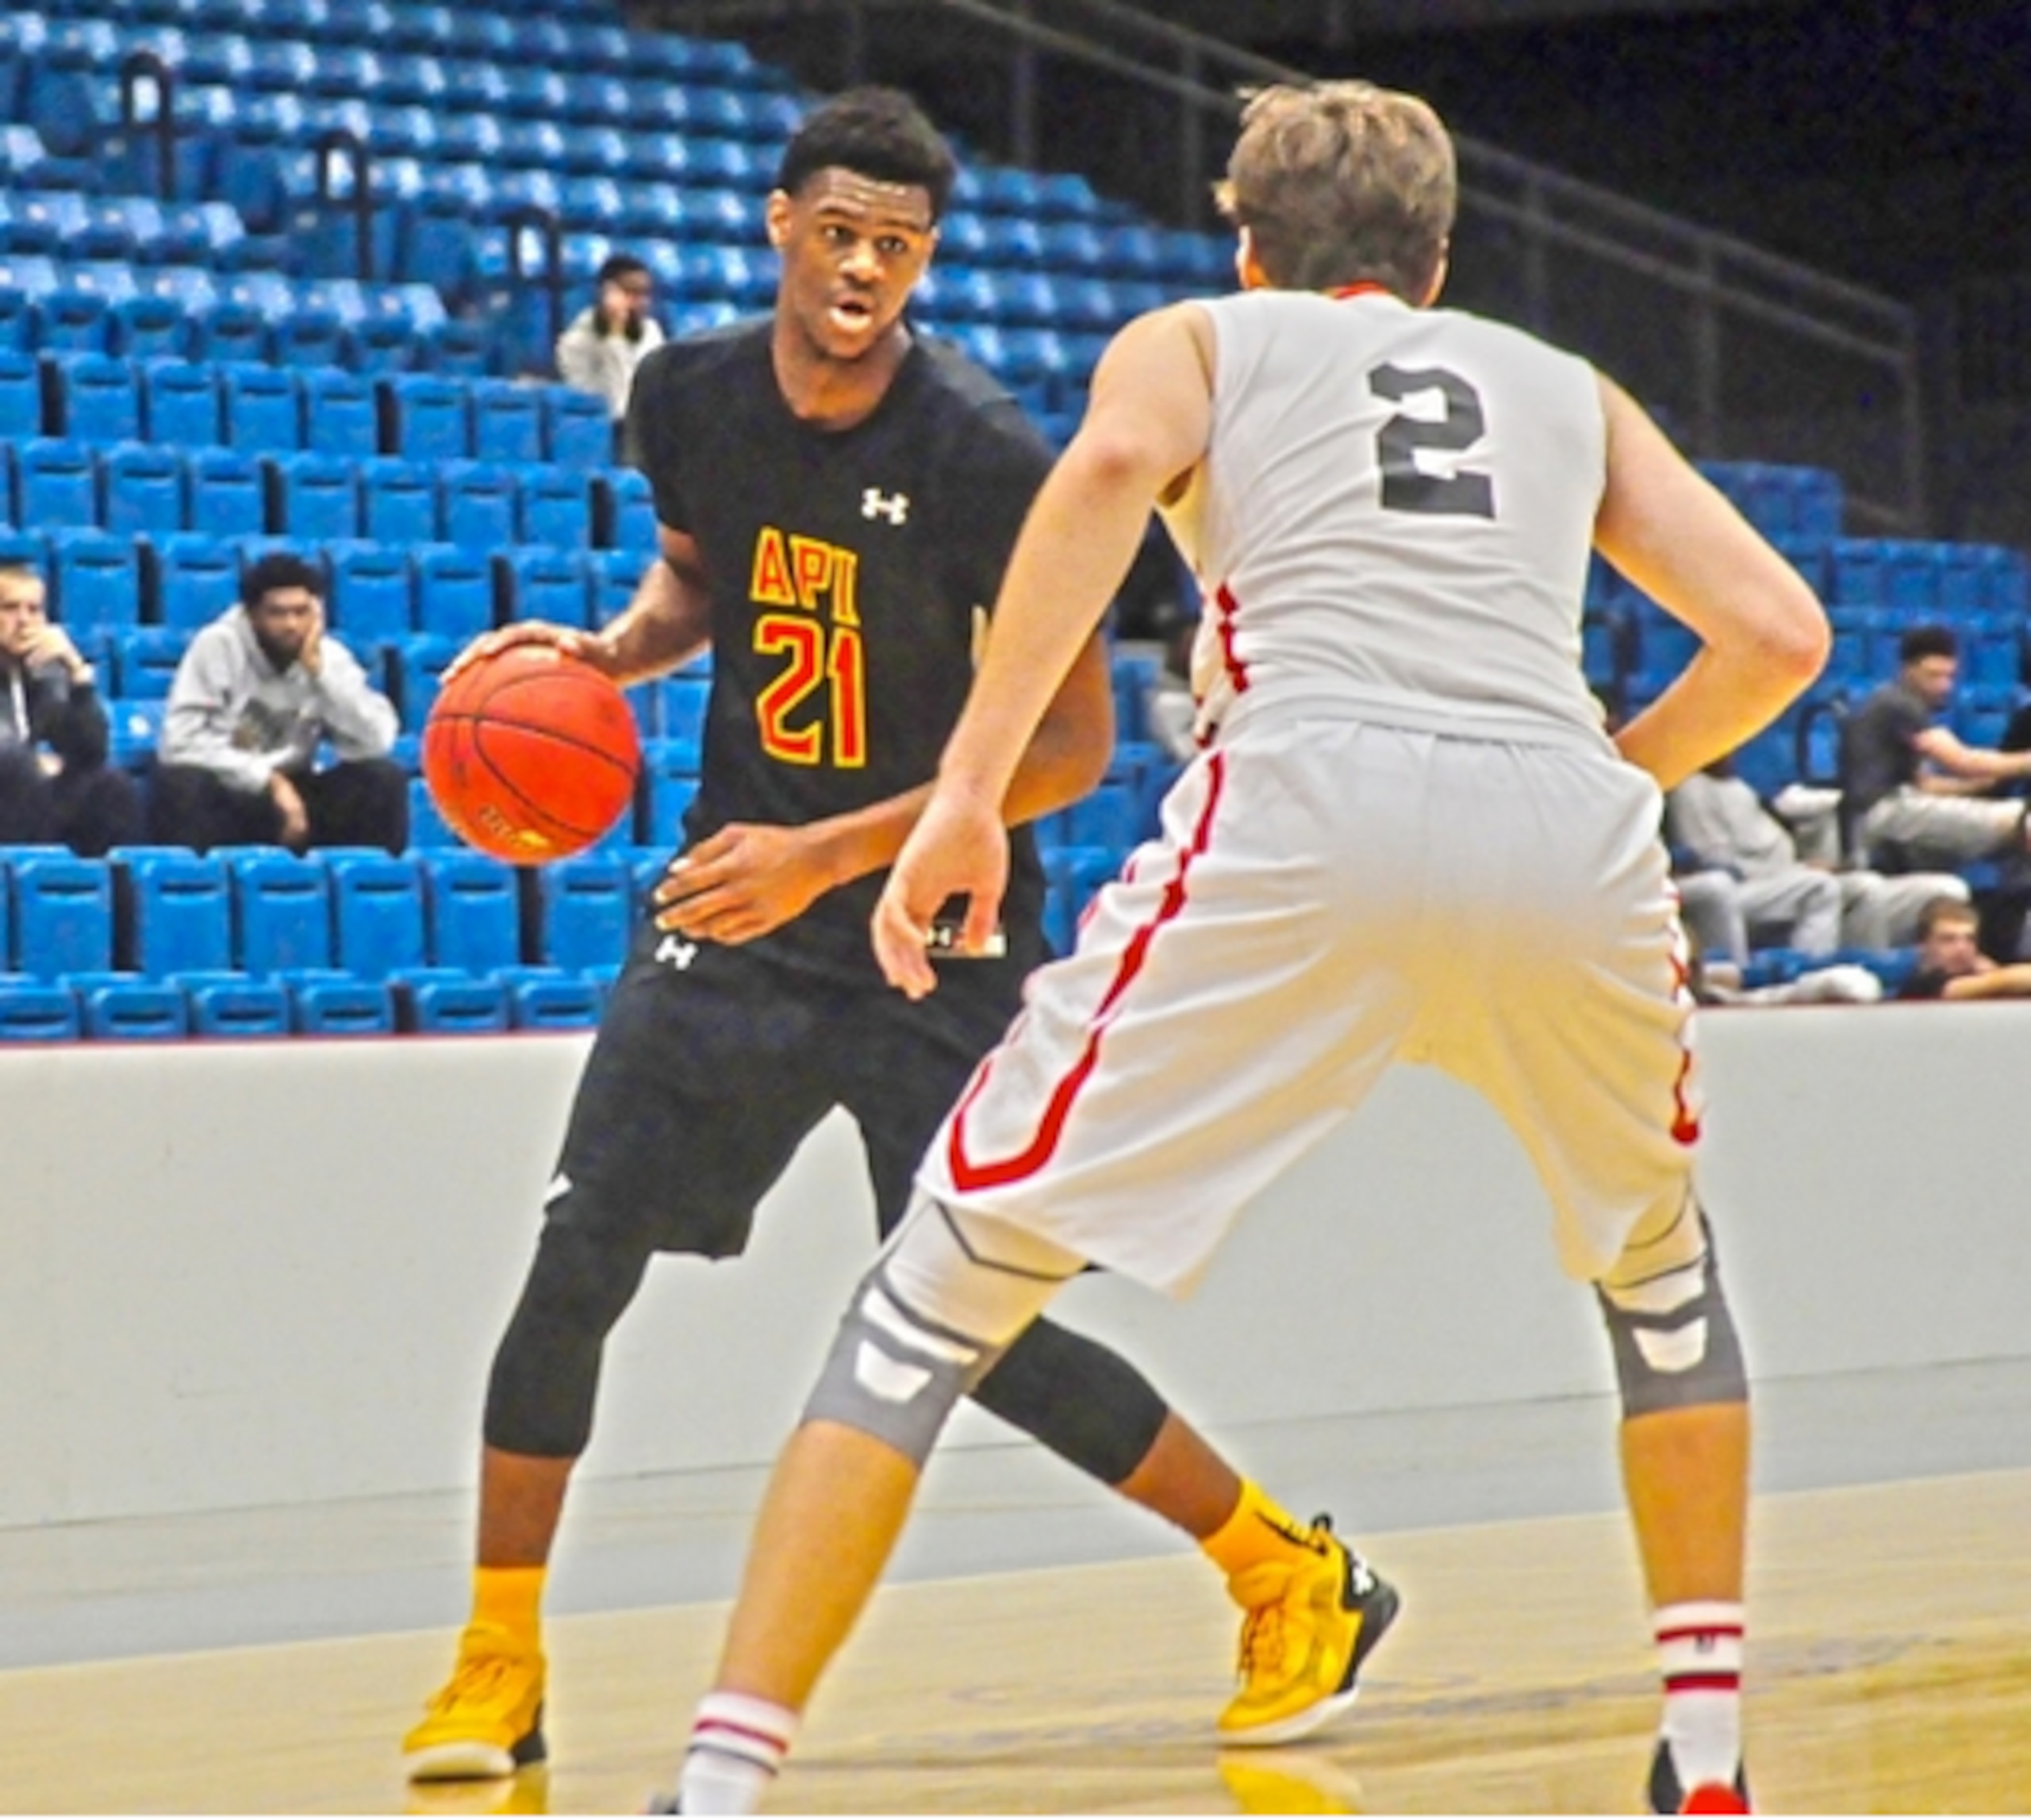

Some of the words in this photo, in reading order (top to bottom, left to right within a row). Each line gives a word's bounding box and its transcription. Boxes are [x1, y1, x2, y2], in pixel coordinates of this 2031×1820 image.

[1368, 362, 1496, 521] 2
[750, 526, 861, 627] API
[753, 614, 866, 768] 21
